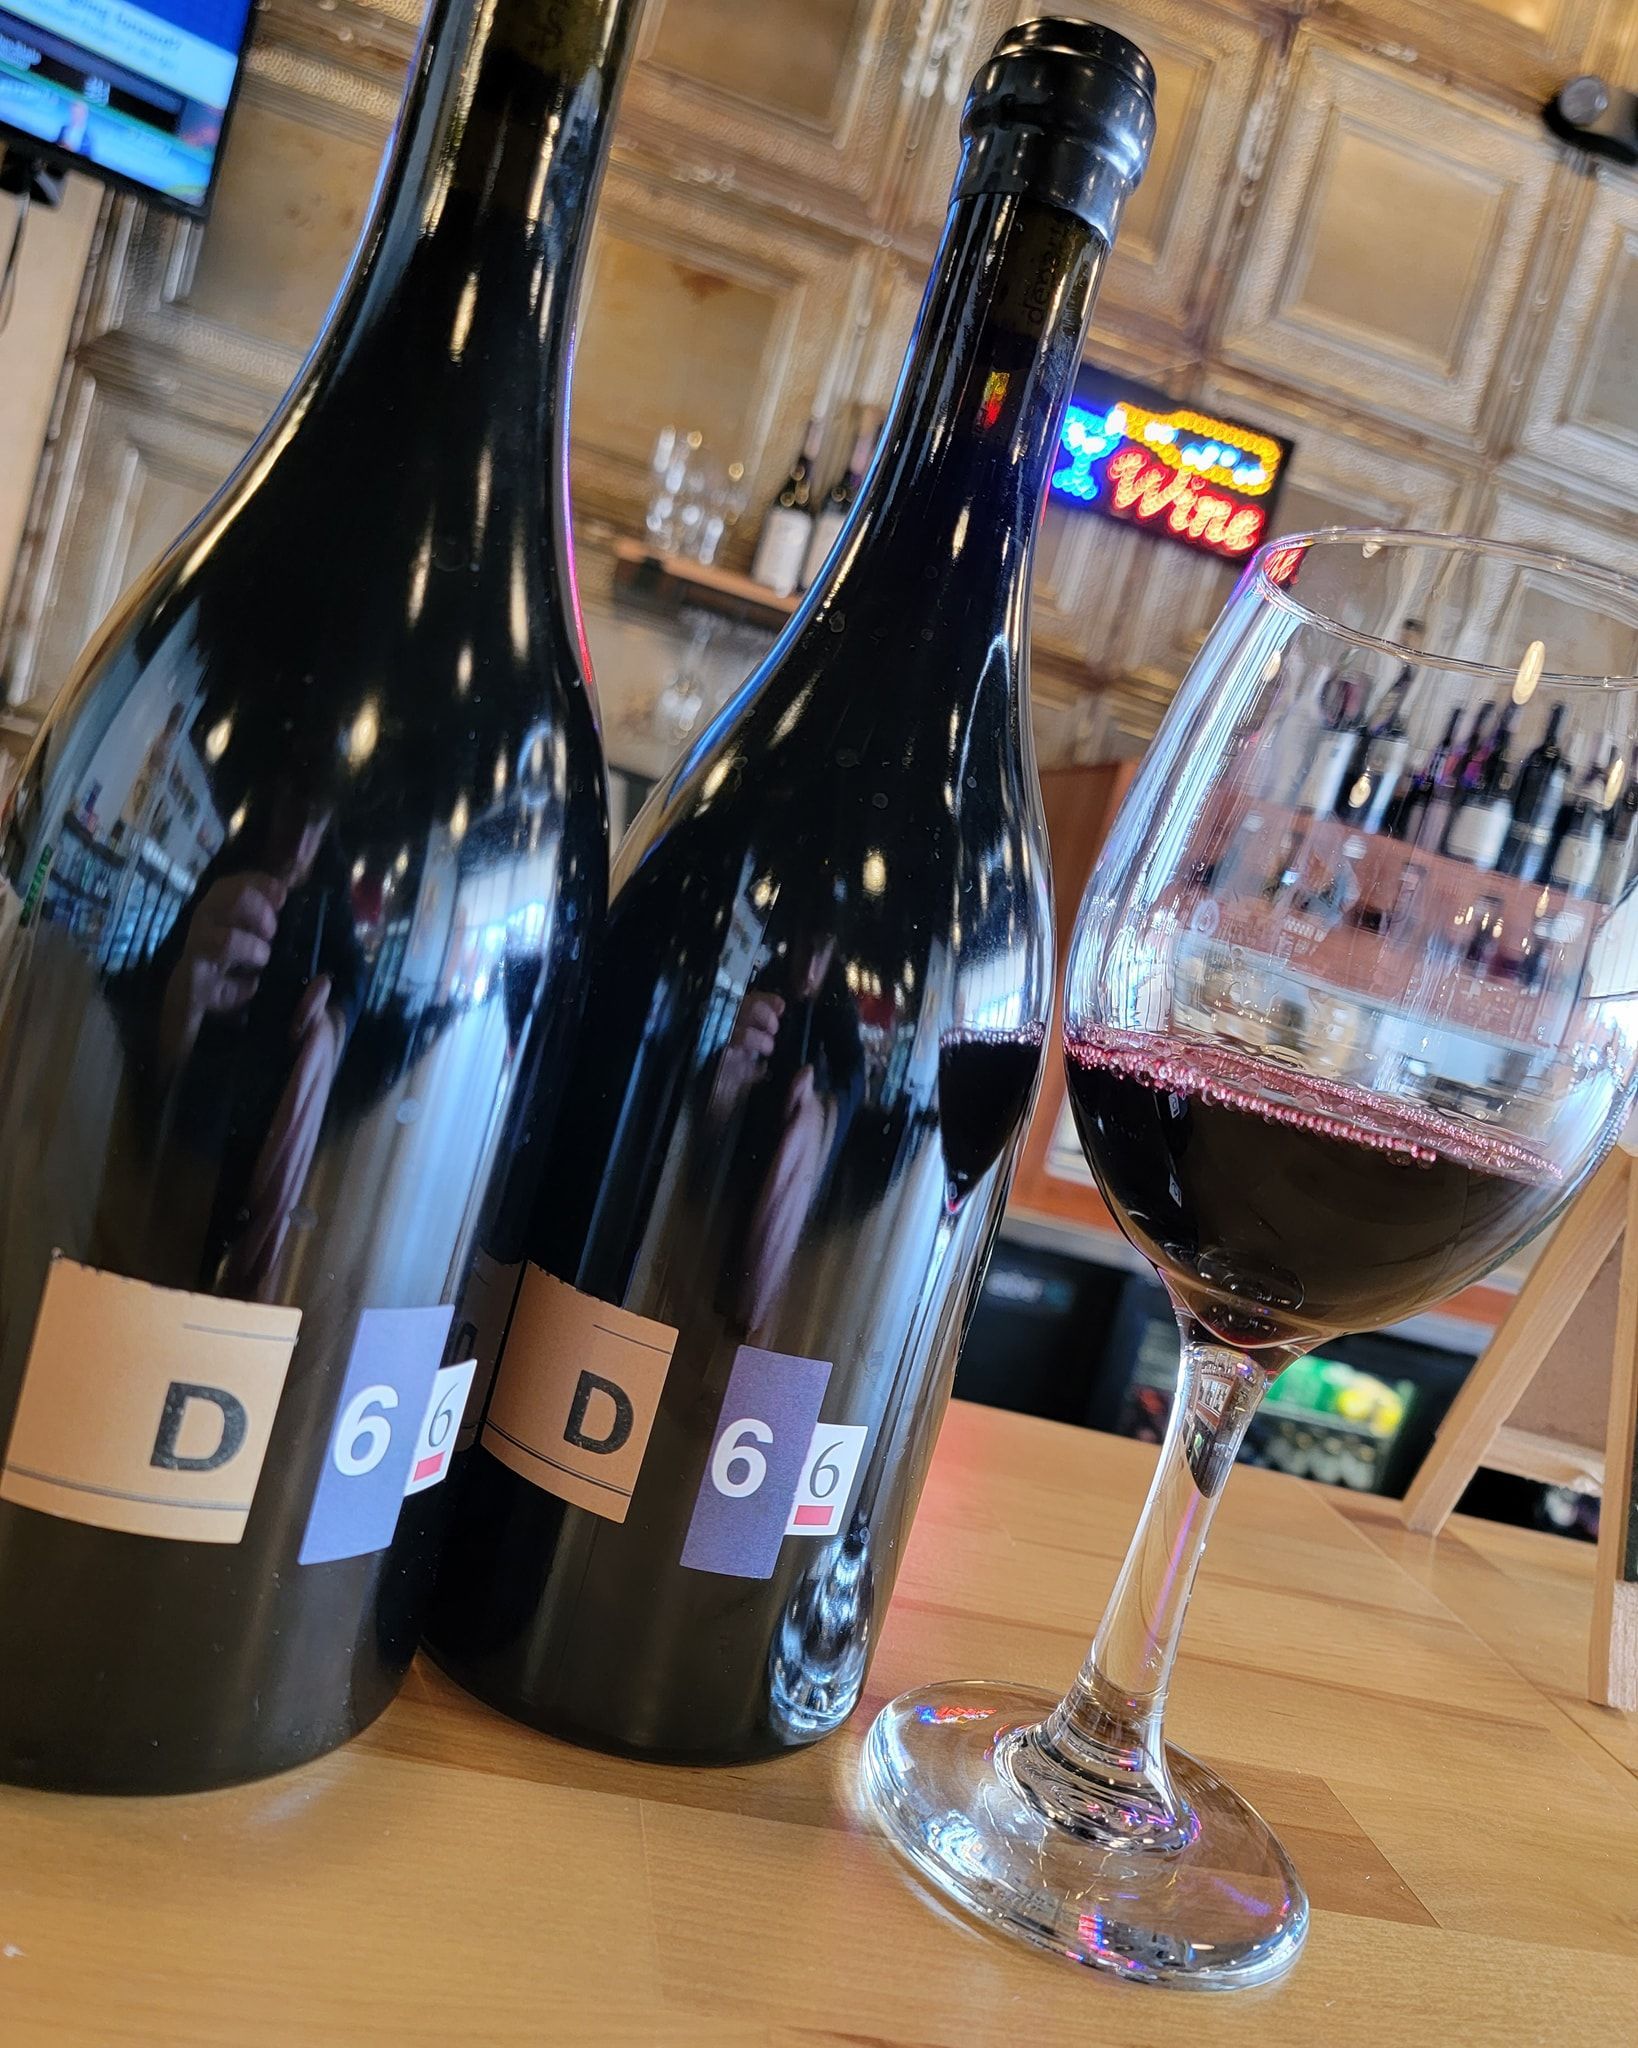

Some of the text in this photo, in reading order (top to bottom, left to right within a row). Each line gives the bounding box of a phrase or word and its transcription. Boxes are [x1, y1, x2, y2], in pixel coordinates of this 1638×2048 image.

[1110, 450, 1264, 553] Wine
[151, 1382, 459, 1476] D 6 6
[564, 1370, 844, 1498] D 6 6
